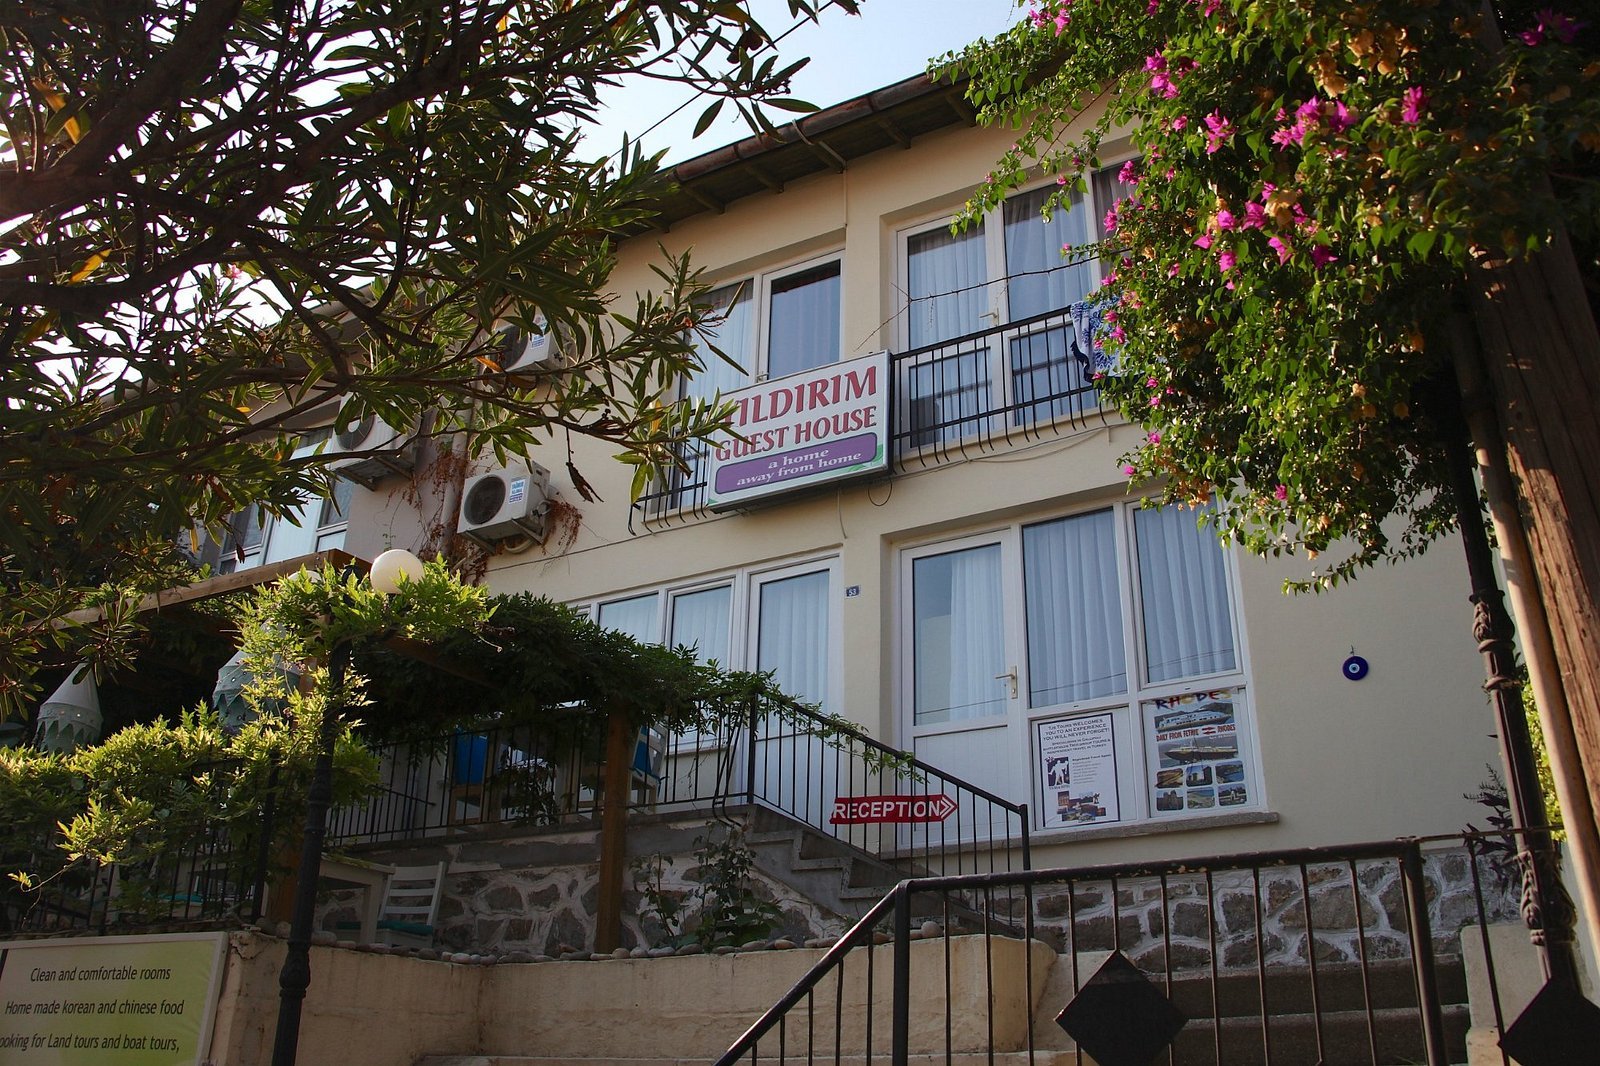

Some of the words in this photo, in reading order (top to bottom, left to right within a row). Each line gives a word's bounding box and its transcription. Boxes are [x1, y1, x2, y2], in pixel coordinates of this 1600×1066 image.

[715, 426, 790, 462] GUEST
[794, 405, 877, 445] HOUSE
[736, 472, 774, 486] away
[778, 464, 814, 477] from
[818, 452, 862, 468] home
[768, 461, 778, 469] a
[783, 449, 829, 466] home
[1154, 689, 1233, 710] RHODES
[1156, 733, 1168, 742] DAILY
[1169, 730, 1183, 739] FROM
[833, 801, 940, 819] RECEPTION
[30, 967, 56, 982] Clean
[58, 967, 77, 981] and
[78, 966, 137, 981] comfortable
[139, 967, 171, 980] rooms
[5, 1002, 31, 1015] Home
[33, 1000, 60, 1015] made
[62, 1000, 95, 1014] korean
[97, 1001, 116, 1014] and
[119, 1000, 157, 1014] chinese
[160, 1000, 185, 1015] food
[30, 1033, 46, 1048] for
[47, 1033, 73, 1048] Land
[74, 1035, 99, 1048] tours
[101, 1034, 121, 1049] and
[123, 1035, 146, 1050] boat
[150, 1035, 180, 1053] tours,
